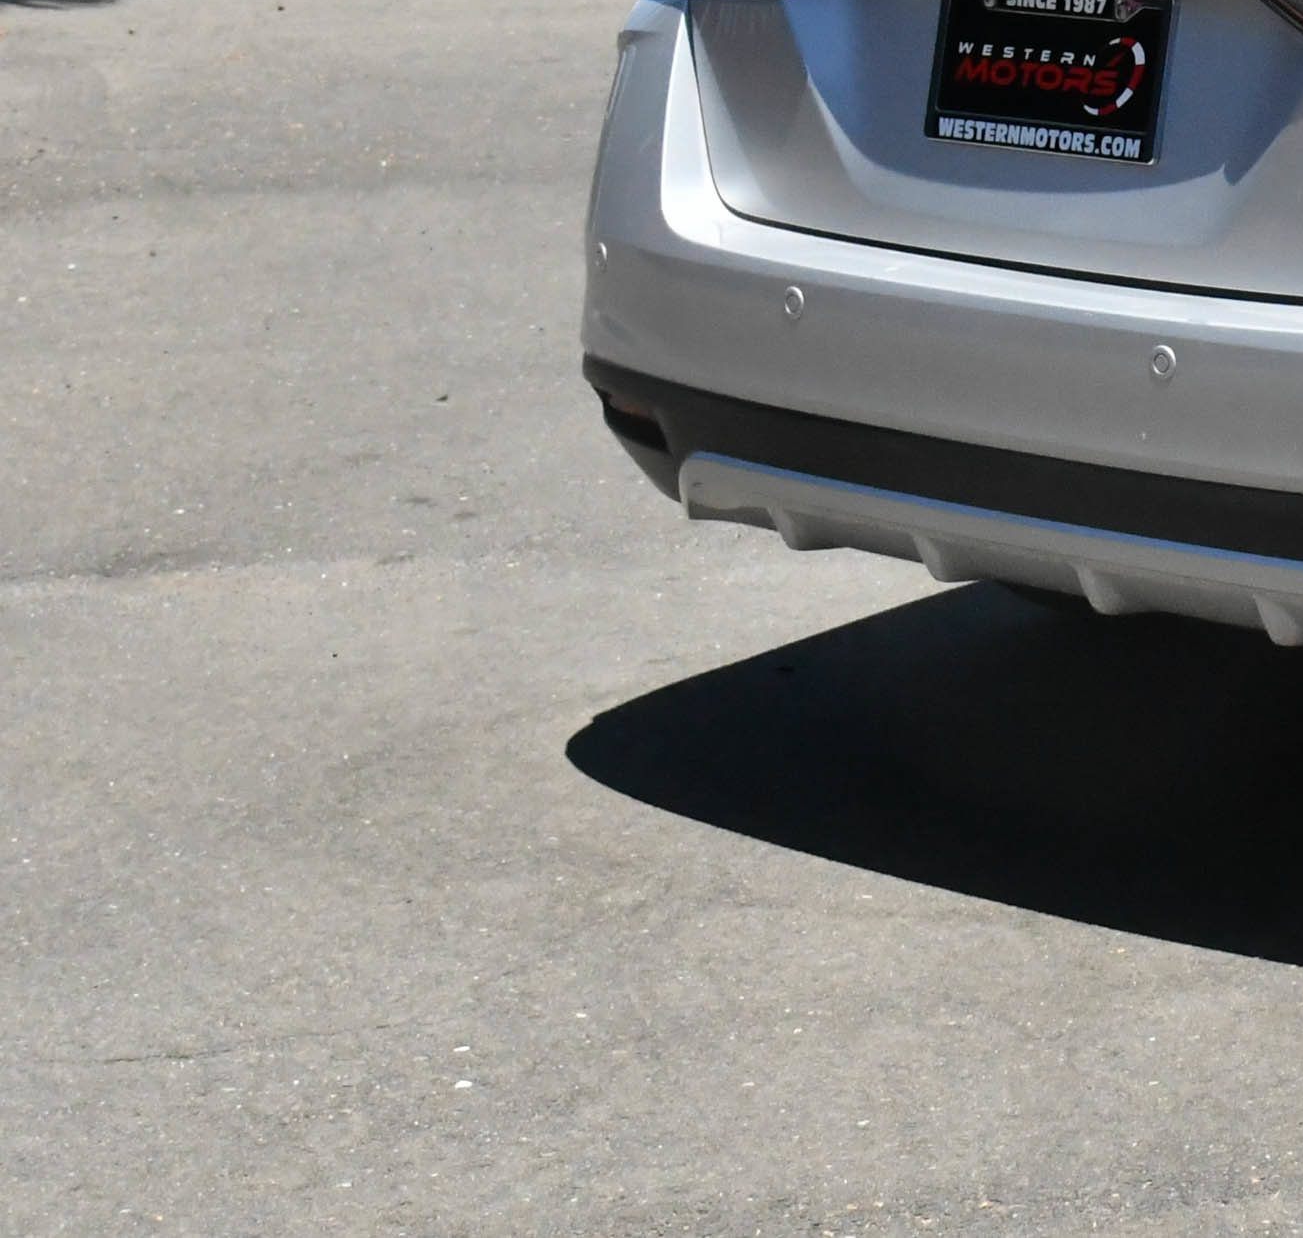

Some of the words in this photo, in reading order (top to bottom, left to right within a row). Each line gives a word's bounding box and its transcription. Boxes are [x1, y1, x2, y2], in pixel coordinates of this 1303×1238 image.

[958, 41, 1097, 67] WESTERN
[955, 57, 1119, 97] MOTORS
[938, 116, 1142, 159] WESTERNMOTORS.COM
